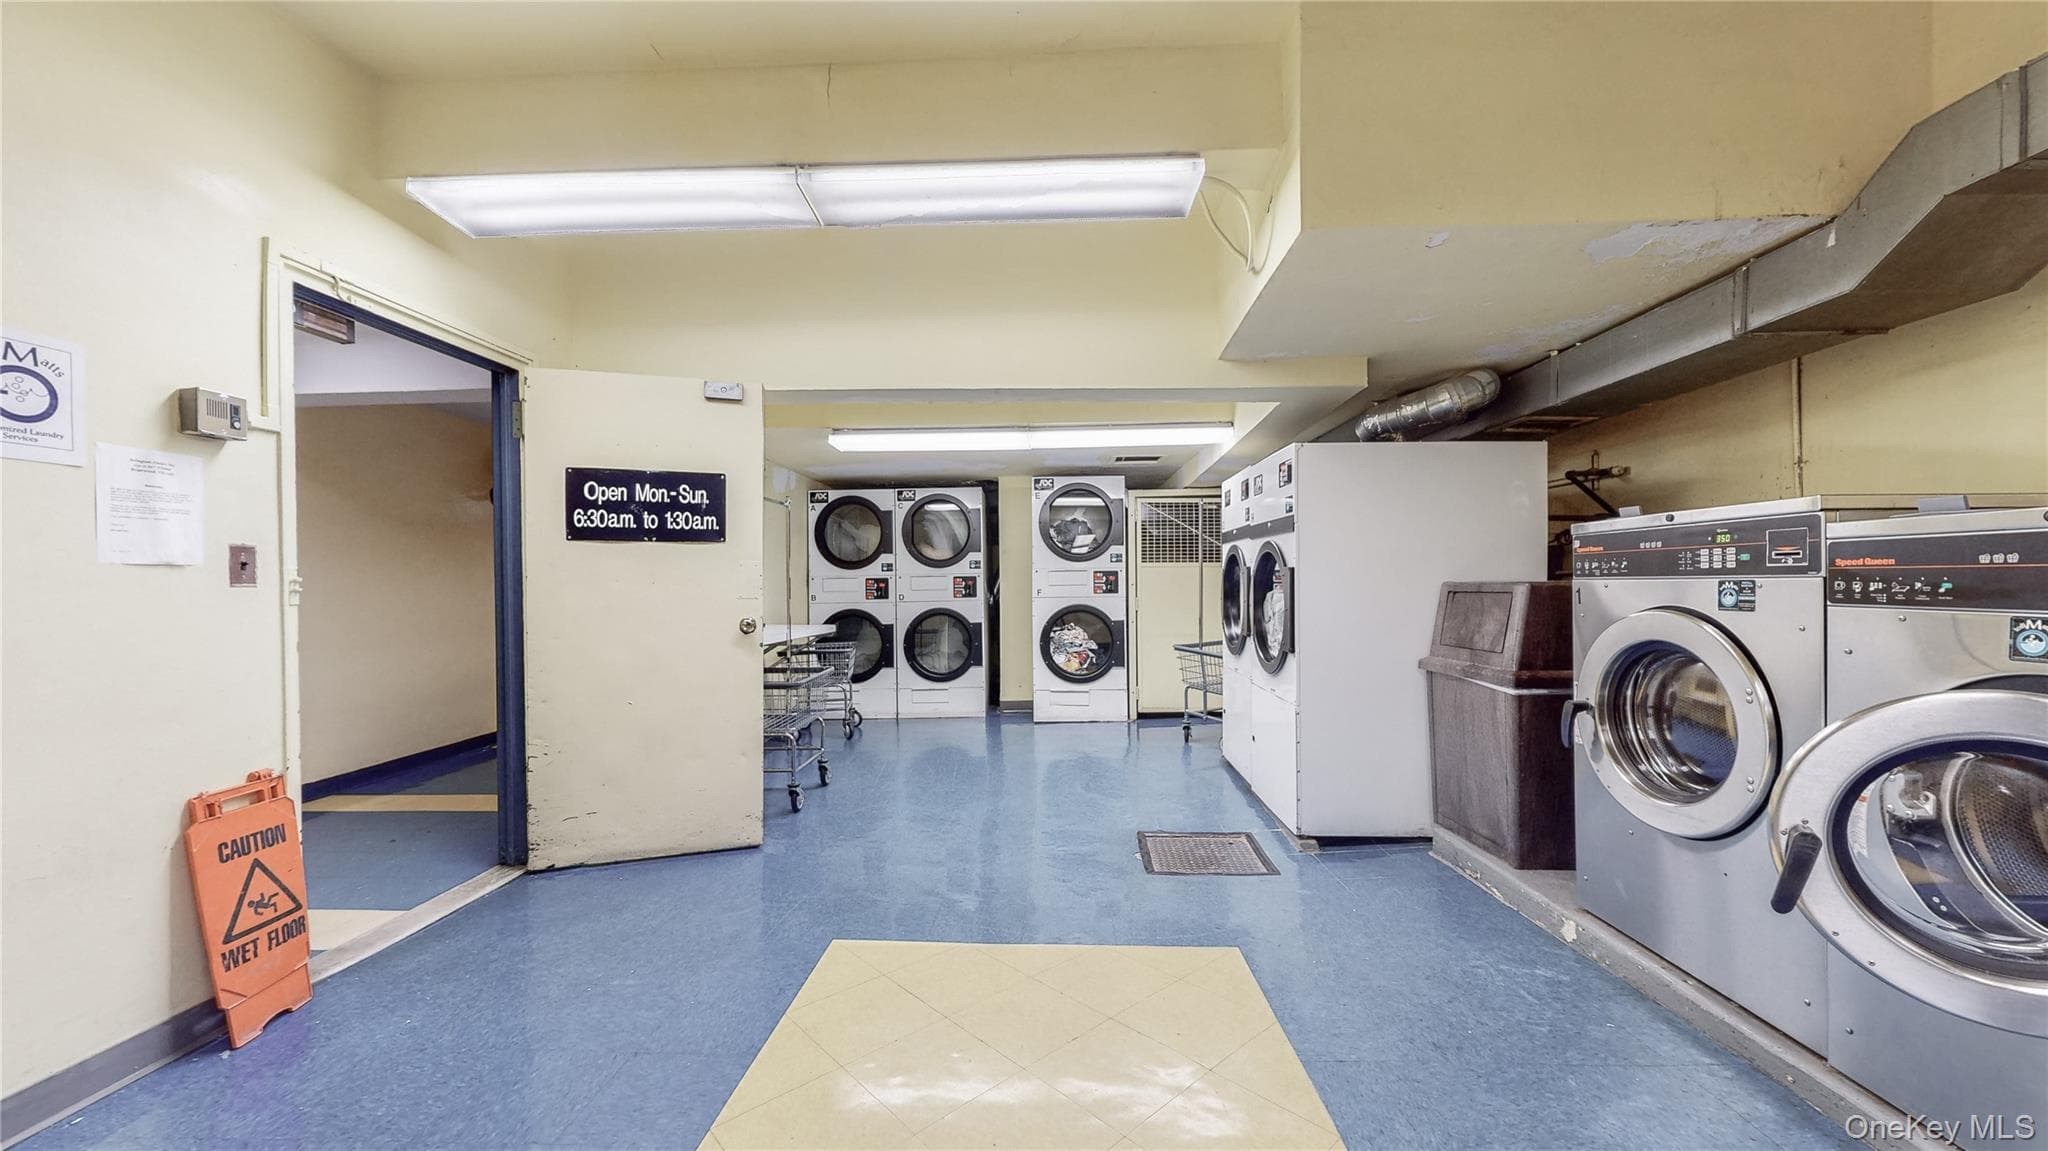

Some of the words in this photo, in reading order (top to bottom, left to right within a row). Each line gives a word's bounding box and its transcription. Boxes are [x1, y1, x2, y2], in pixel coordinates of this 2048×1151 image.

[3, 432, 38, 442] Services
[583, 481, 627, 505] Open
[1034, 492, 1041, 500] E
[573, 509, 637, 529] 6:30a.m.
[643, 511, 658, 529] to
[1834, 558, 1864, 567] Speed
[1865, 557, 1896, 566] Queen
[1575, 587, 1582, 605] 1
[217, 823, 287, 864] CAUTION
[221, 937, 260, 973] WET
[267, 915, 306, 951] FLOOR
